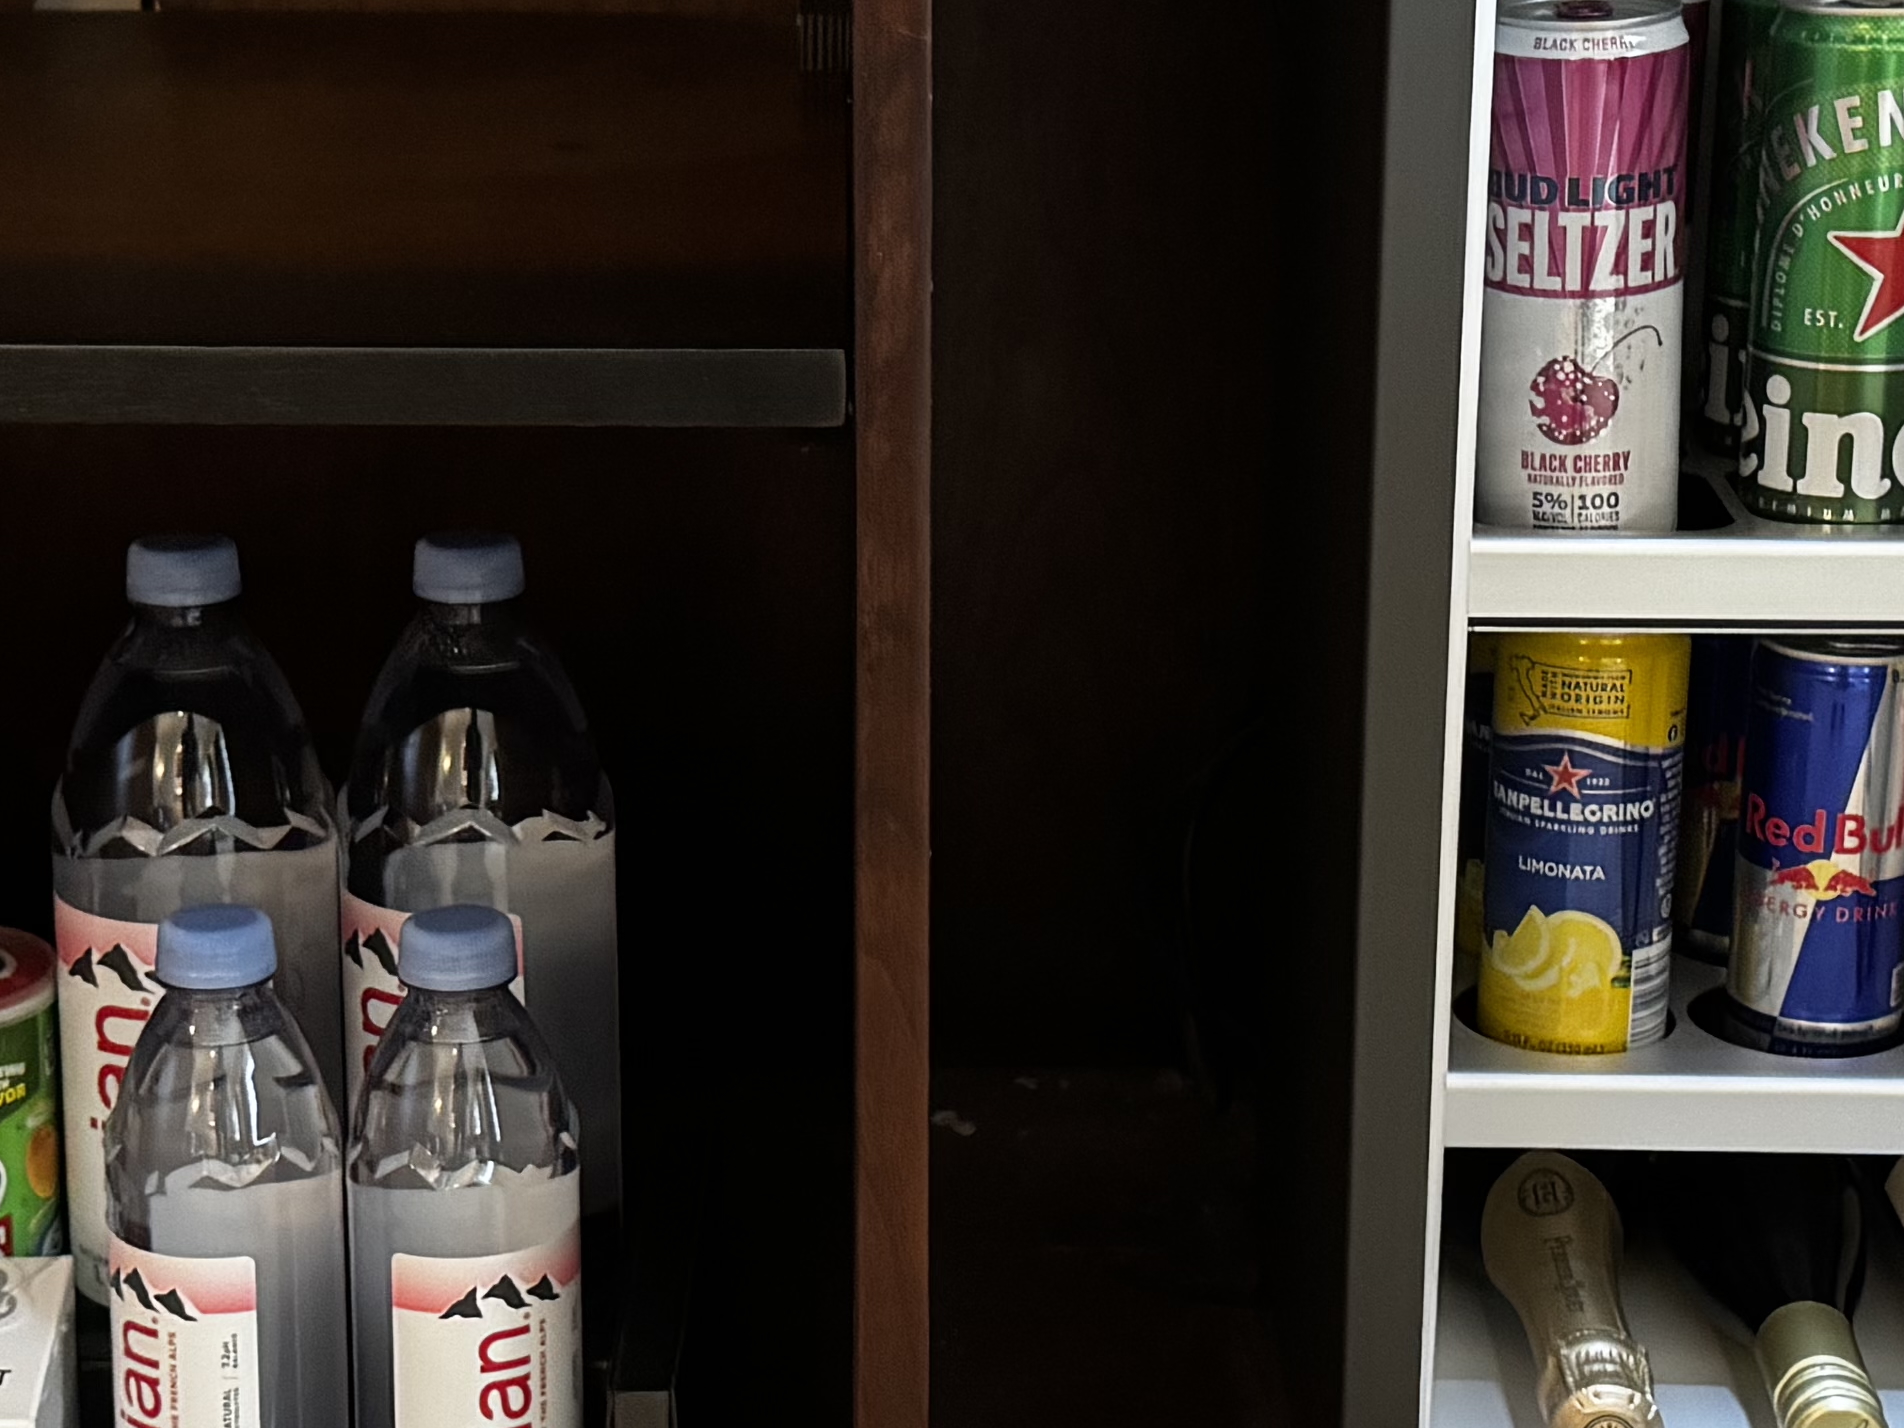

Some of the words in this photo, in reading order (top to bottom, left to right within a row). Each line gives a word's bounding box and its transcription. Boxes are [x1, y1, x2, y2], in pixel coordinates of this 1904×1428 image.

[1533, 37, 1577, 52] BLACK
[1583, 34, 1637, 52] CHERR
[1566, 164, 1678, 208] LIGHT
[1486, 201, 1677, 292] SELTZER
[1804, 308, 1844, 329] EST.
[1521, 449, 1567, 474] BLACK
[1573, 450, 1631, 474] CHERRY
[1527, 473, 1576, 487] NATURALLY
[1579, 473, 1625, 487] FLAVORED
[1532, 491, 1568, 510] 5%
[1578, 492, 1620, 510] 100
[1577, 510, 1620, 523] CALORIES
[1561, 681, 1625, 694] NATURAL
[1561, 693, 1625, 706] ORIGIN
[1747, 793, 1827, 853] Red
[1518, 855, 1606, 881] LIMONATA
[168, 1332, 177, 1362] ALPS
[169, 1364, 178, 1411] FRENCH
